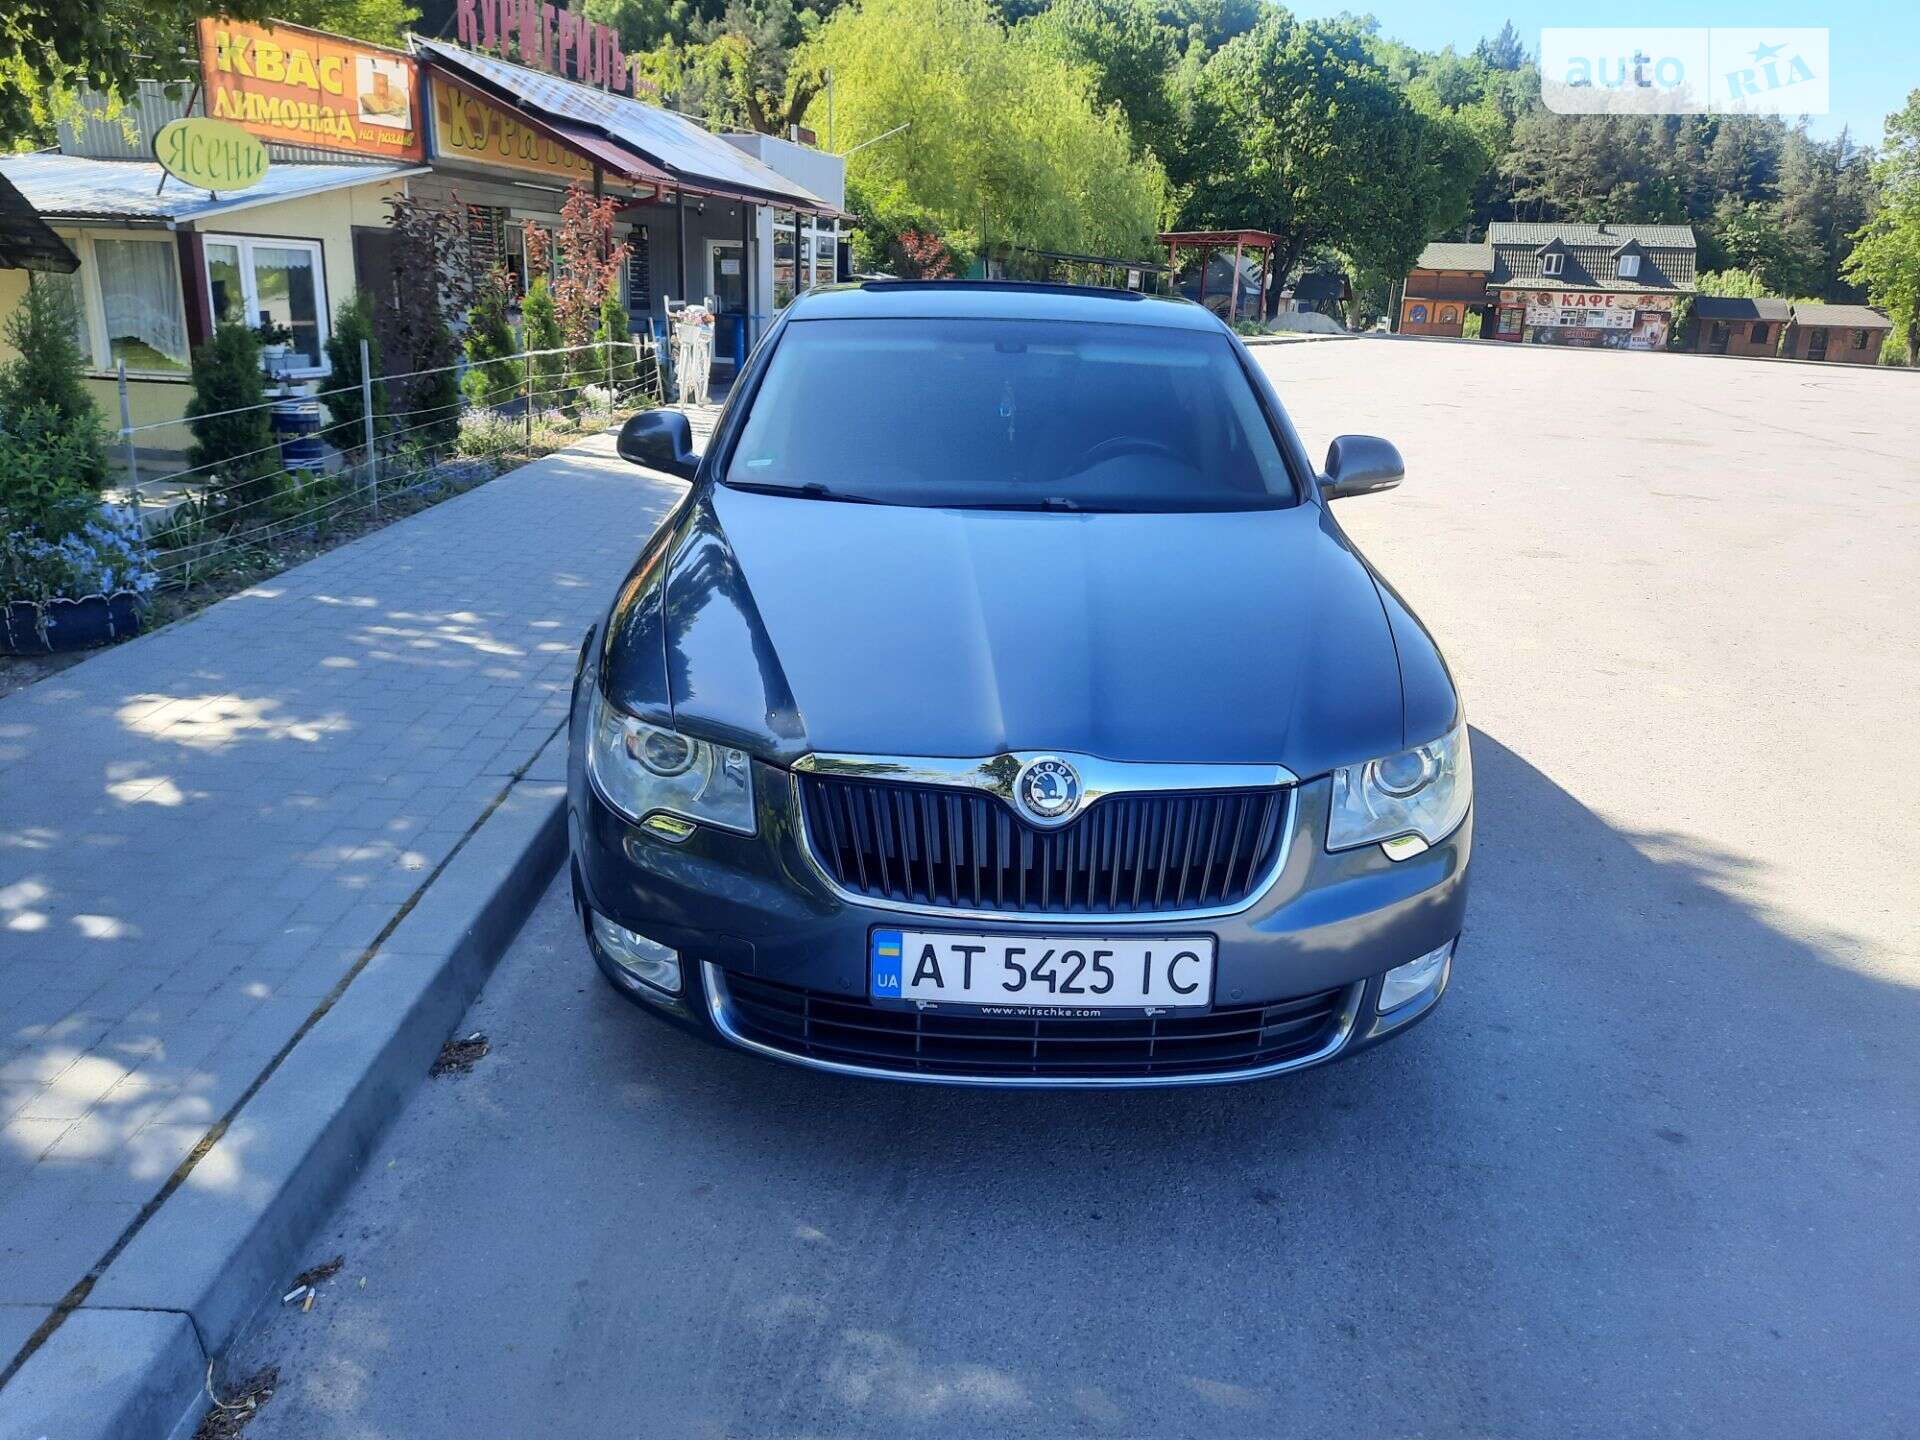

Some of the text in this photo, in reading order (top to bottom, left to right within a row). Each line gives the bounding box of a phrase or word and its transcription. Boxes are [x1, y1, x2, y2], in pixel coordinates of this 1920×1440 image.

[214, 30, 344, 96] КВАС
[168, 126, 262, 181] Ясени
[1561, 293, 1615, 308] КАФЕ
[877, 973, 899, 988] UA
[911, 943, 1200, 995] AT 5425 IC
